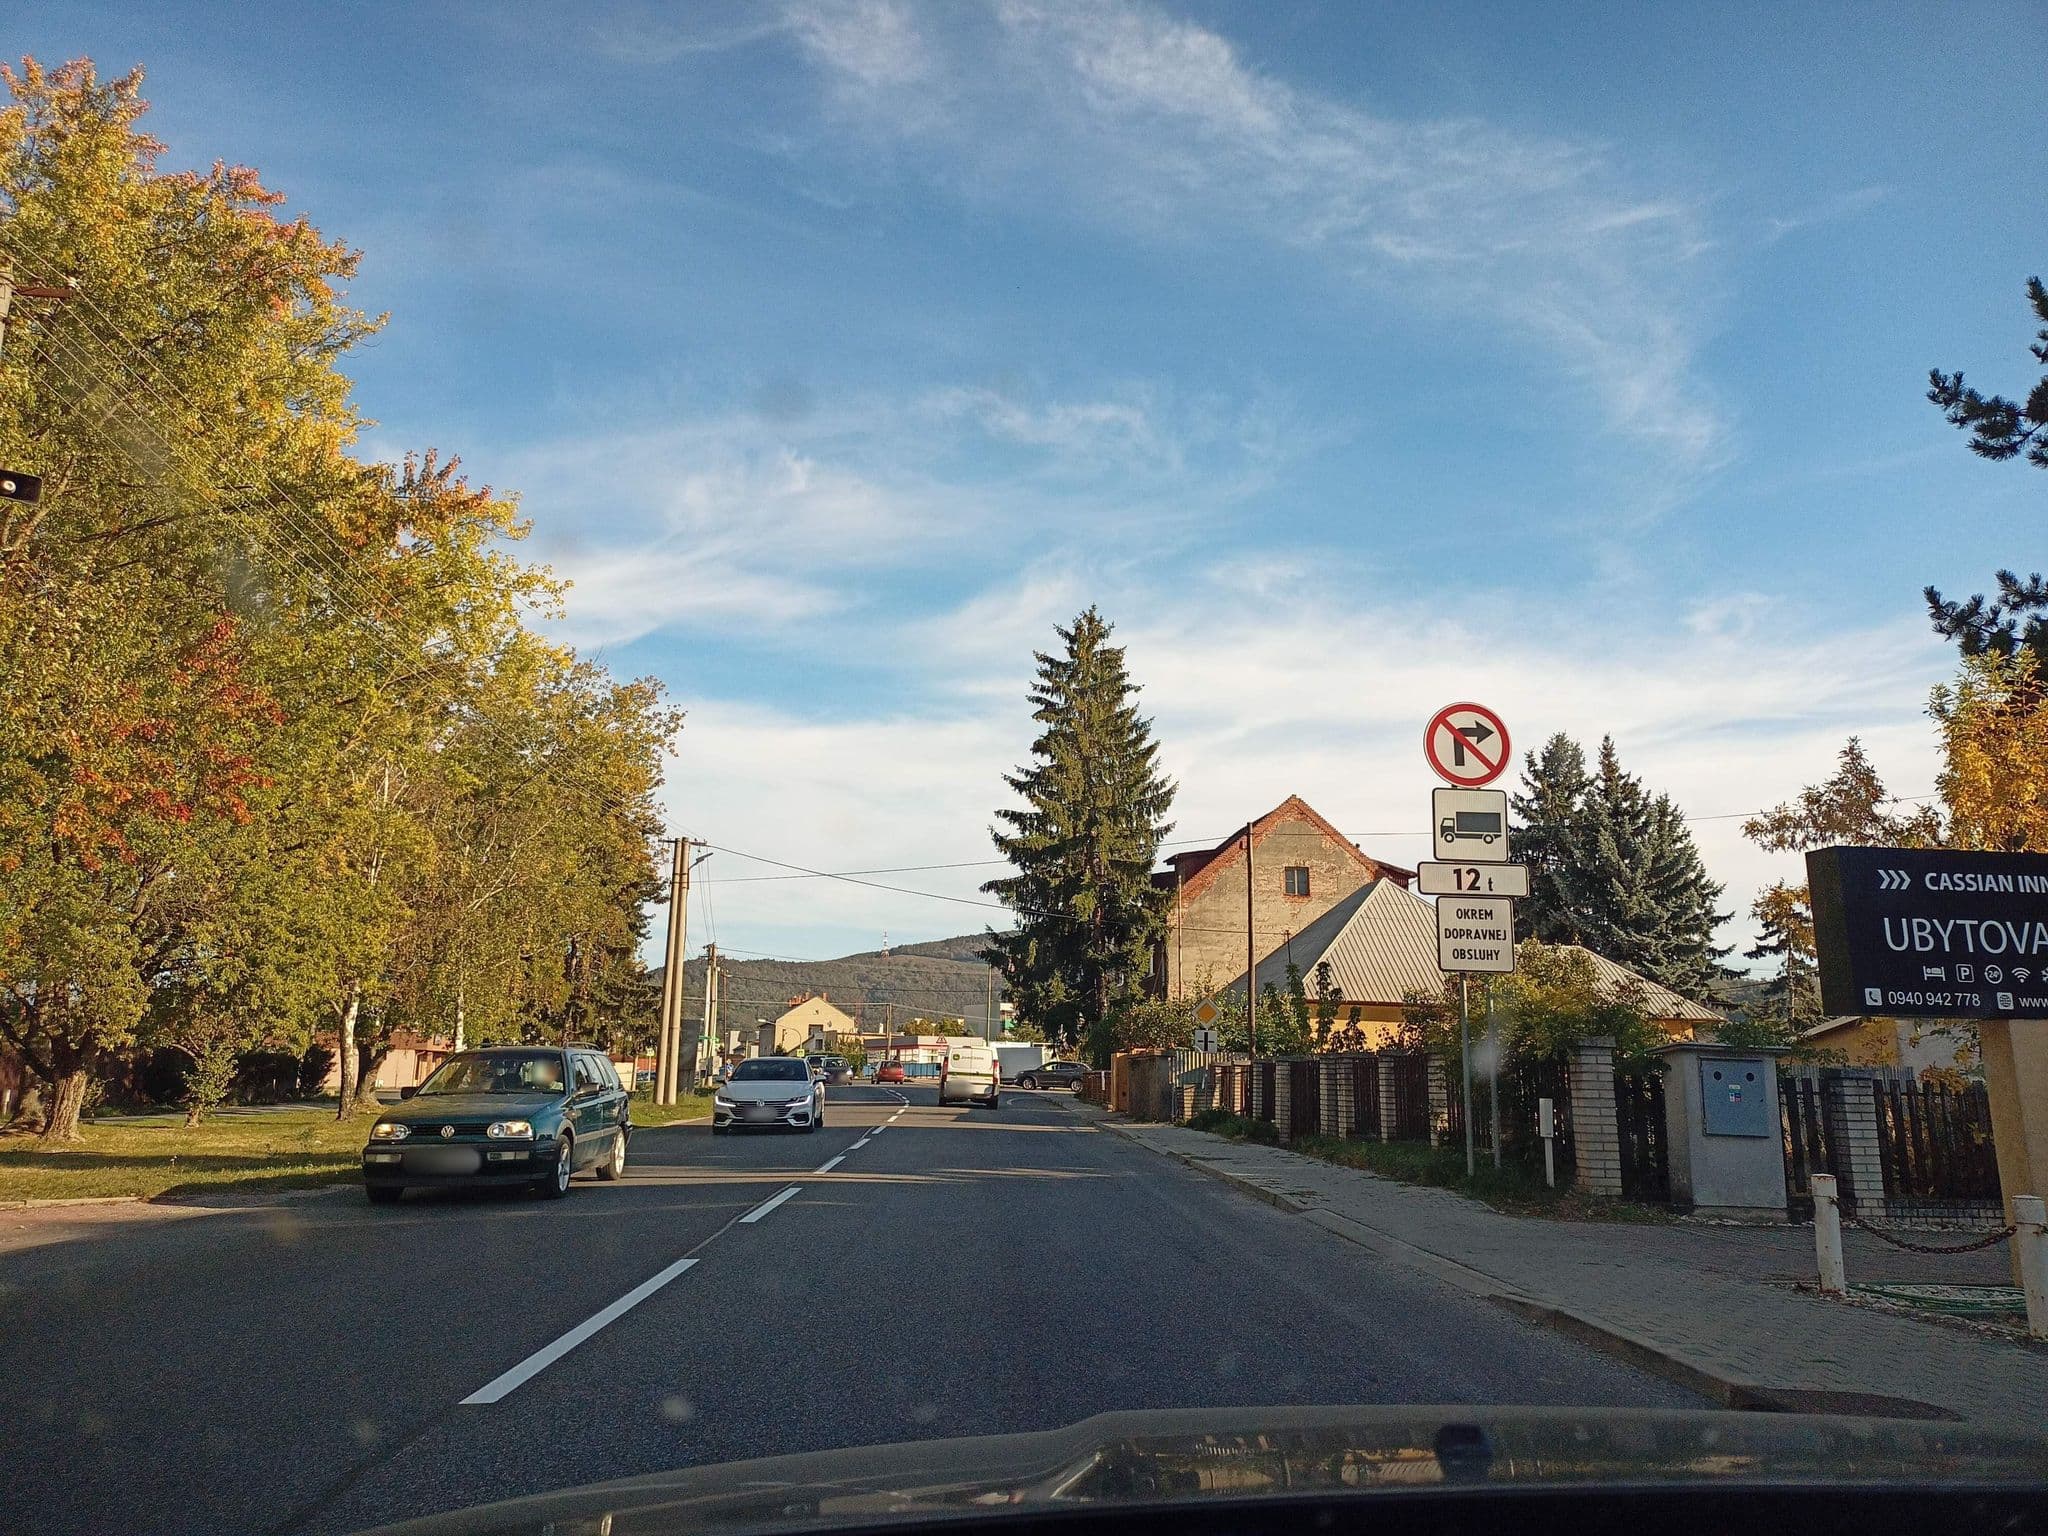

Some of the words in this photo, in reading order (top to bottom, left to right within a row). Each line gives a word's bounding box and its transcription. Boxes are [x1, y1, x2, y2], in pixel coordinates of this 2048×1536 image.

[1453, 868, 1481, 891] 12
[1488, 877, 1494, 892] t
[1925, 872, 2014, 893] CASSIAN
[1456, 908, 1493, 920] OKREM
[1444, 928, 1507, 941] DOPRAVNEJ
[1884, 917, 2048, 955] UBYTOVA
[1452, 948, 1500, 961] OBSLUHY
[1888, 991, 1923, 1006] 0940
[1926, 992, 1952, 1006] 942
[1954, 993, 1981, 1007] 778
